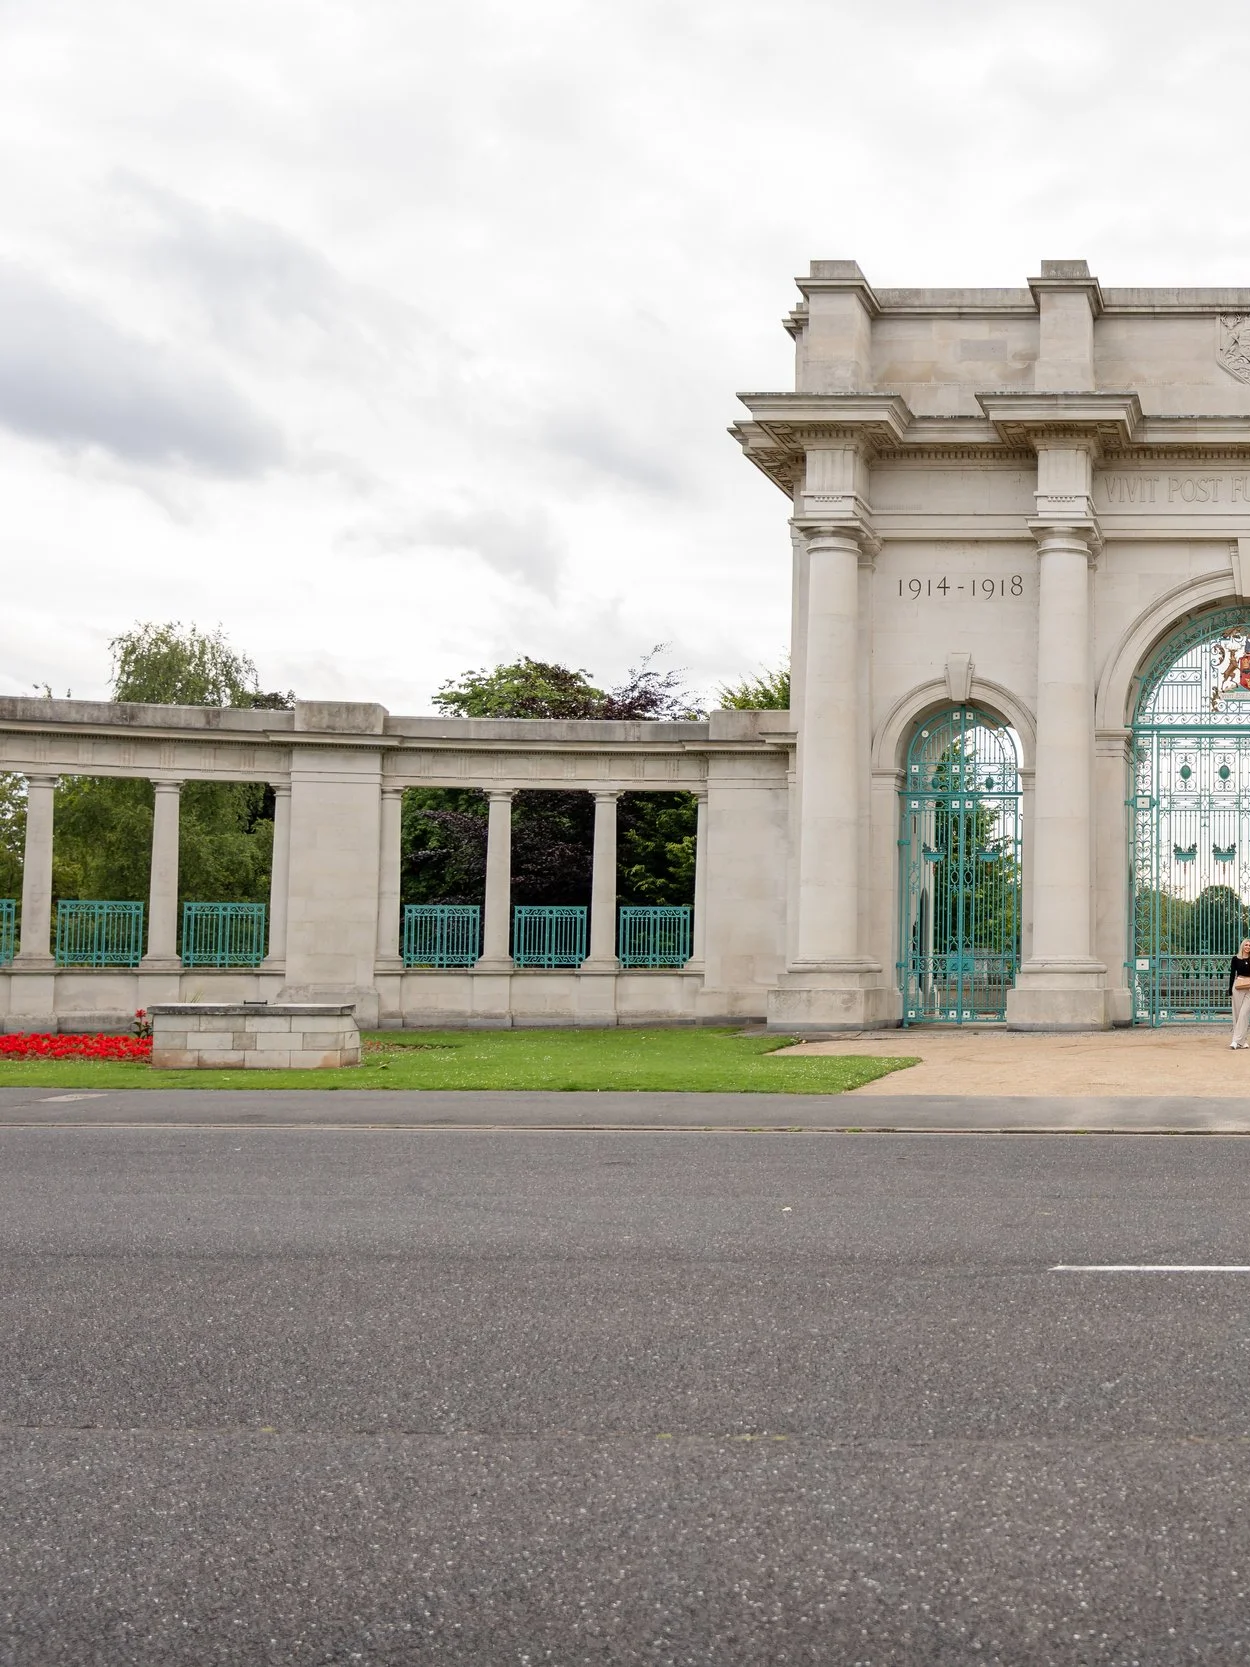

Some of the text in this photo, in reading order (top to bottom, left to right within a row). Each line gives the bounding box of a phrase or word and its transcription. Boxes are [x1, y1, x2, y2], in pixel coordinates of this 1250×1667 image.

[1104, 476, 1160, 503] VIVIT
[1168, 476, 1223, 503] POST
[898, 575, 1024, 601] 1914-1918
